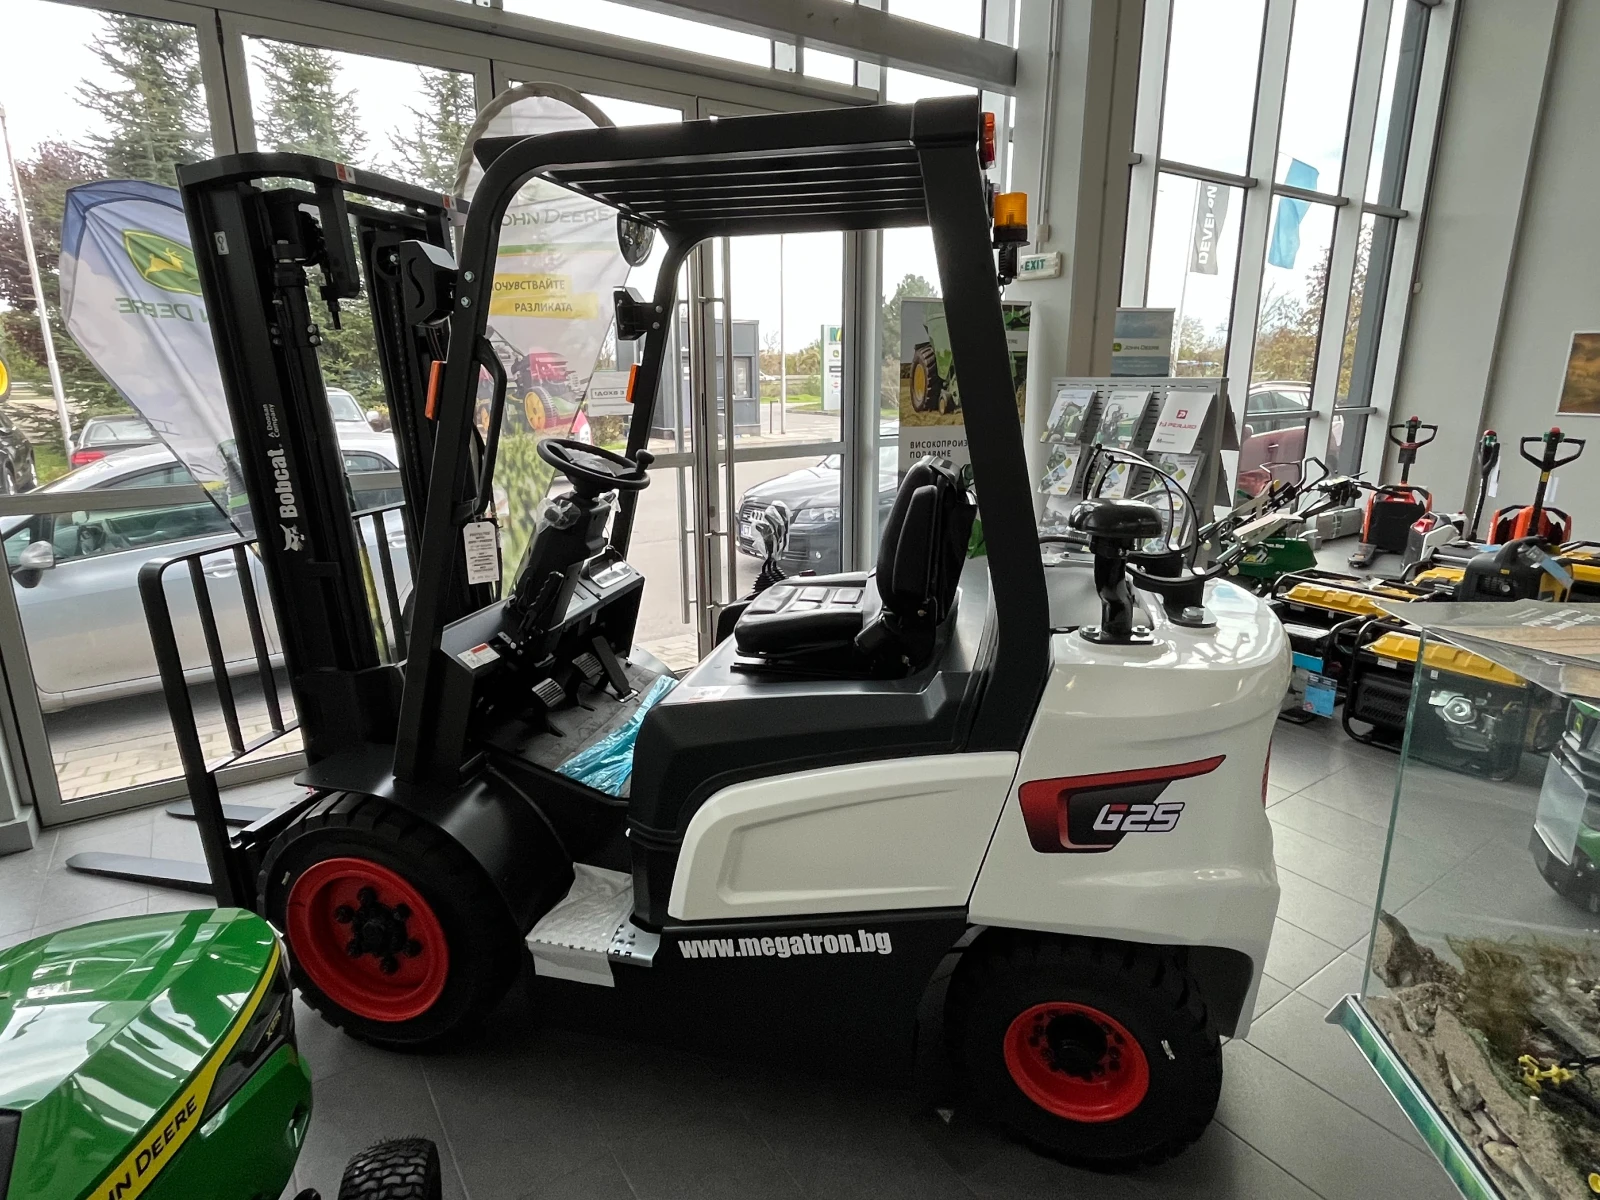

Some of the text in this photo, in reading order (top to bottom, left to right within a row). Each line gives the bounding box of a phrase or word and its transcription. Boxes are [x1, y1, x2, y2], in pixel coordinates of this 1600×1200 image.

[500, 208, 610, 227] OHN DEERE
[1025, 259, 1046, 271] EXIT
[491, 278, 565, 291] ОЧУВСТВАЙТЕ
[514, 302, 573, 312] РАЗЛИКАТА
[262, 404, 273, 431] Doosan
[268, 404, 280, 438] Company
[910, 439, 969, 449] ВИСОКОПРОИЗ
[910, 450, 952, 459] ПОДАВАНЕ
[267, 448, 298, 519] Bobcat
[1092, 802, 1185, 832] G25
[678, 929, 892, 959] www.megatron.bg
[135, 1095, 198, 1177] DEERE
